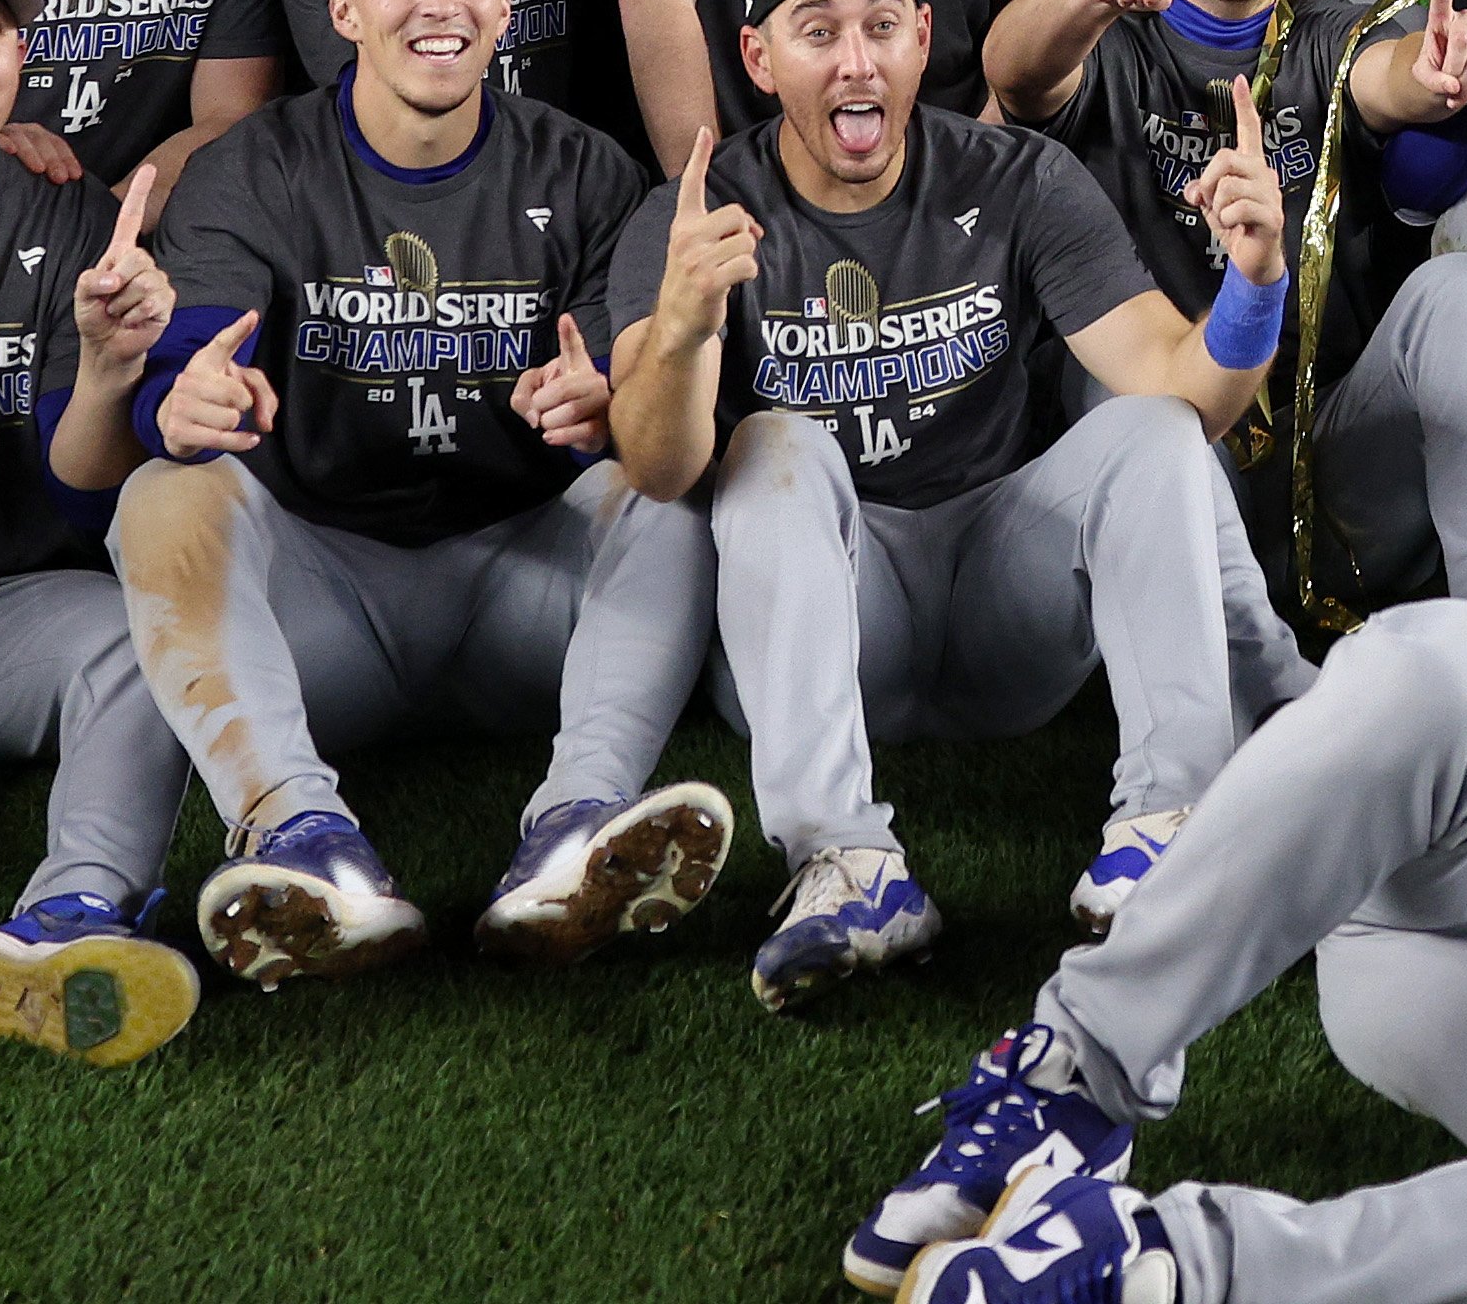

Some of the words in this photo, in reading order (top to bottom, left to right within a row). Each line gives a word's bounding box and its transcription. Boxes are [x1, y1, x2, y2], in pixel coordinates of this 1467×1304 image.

[304, 282, 432, 327] WORLD
[878, 285, 1003, 343] SERIES
[296, 319, 532, 374] CHAMPION
[753, 319, 1012, 405] CHAMPIONS
[368, 387, 395, 404] 20
[455, 387, 482, 404] 24
[907, 404, 937, 421] 24
